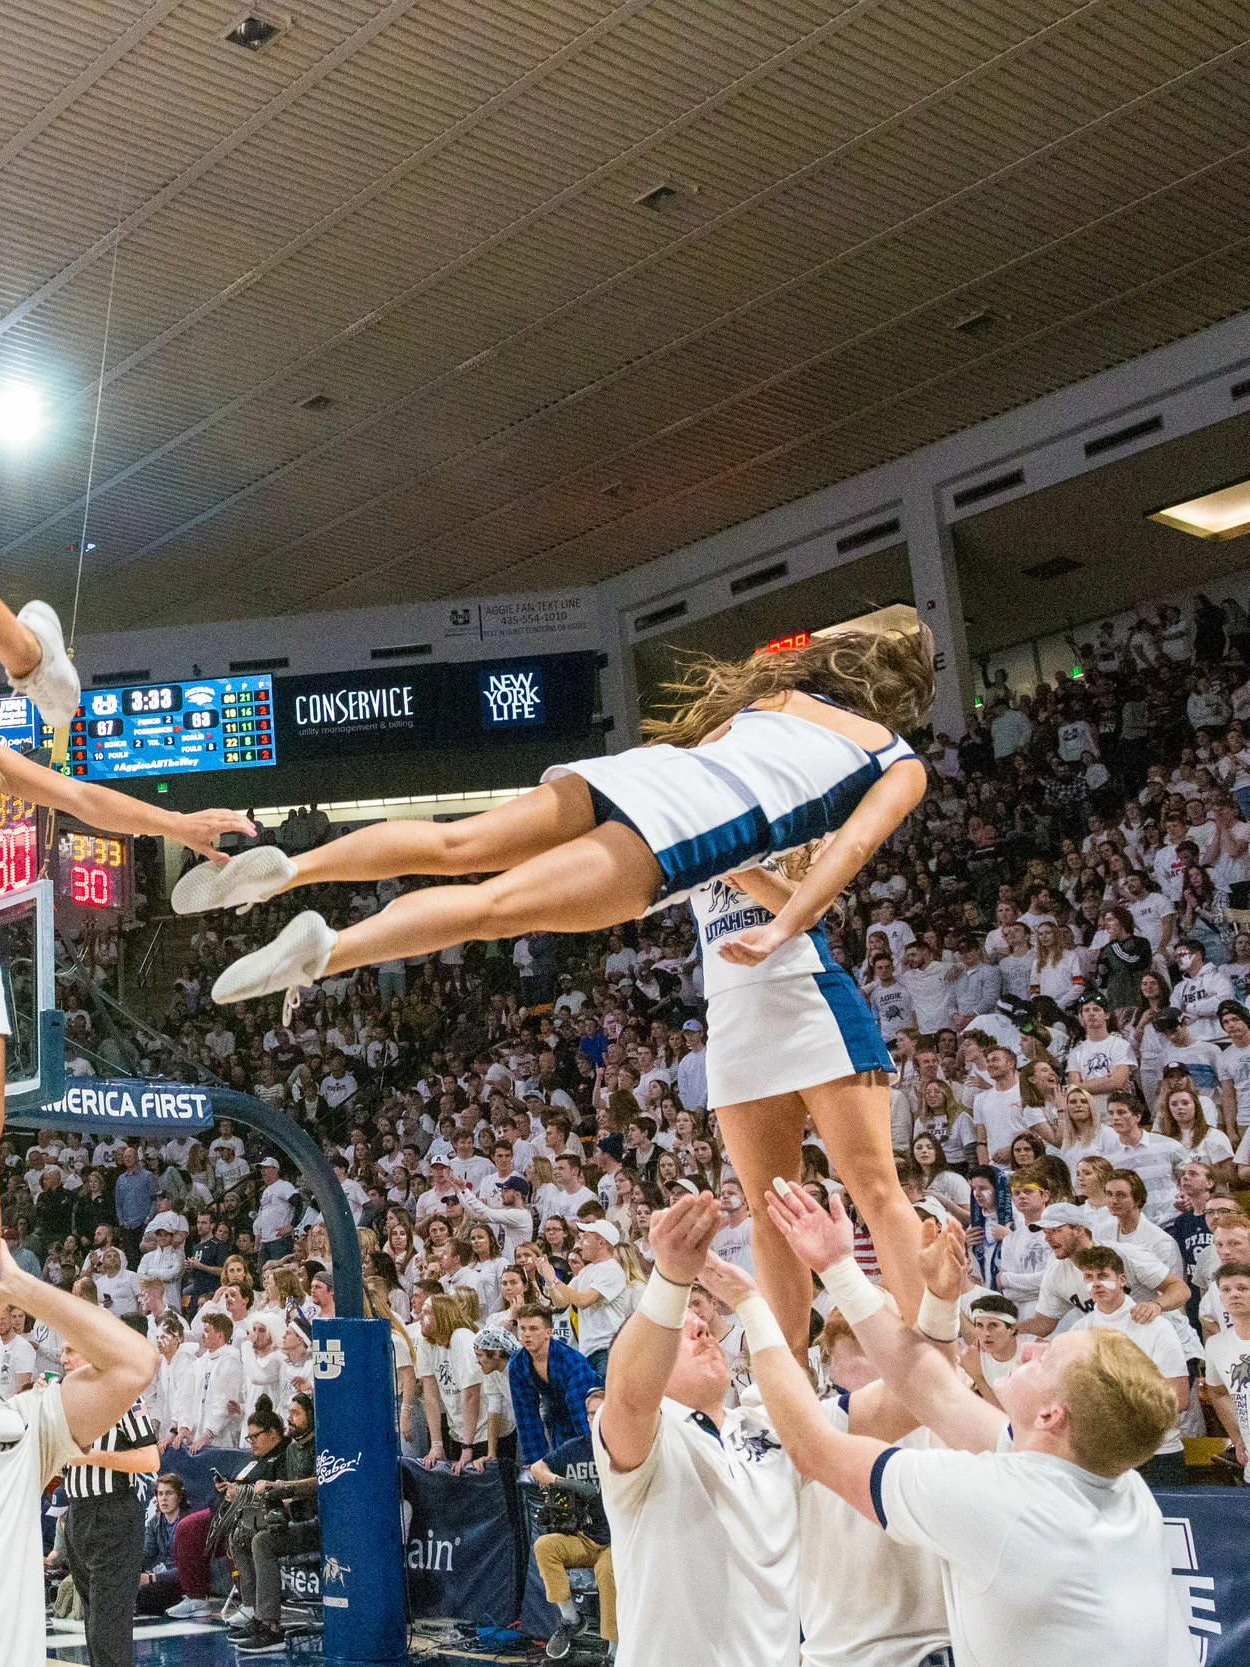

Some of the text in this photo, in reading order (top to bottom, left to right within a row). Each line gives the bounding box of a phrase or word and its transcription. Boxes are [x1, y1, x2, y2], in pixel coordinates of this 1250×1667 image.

[485, 598, 581, 615] AGGIE FAN TEXT LINE
[501, 612, 568, 625] 435-554-1010
[489, 672, 534, 692] NEW
[131, 688, 172, 711] 3:33
[240, 693, 251, 702] 21
[258, 691, 266, 700] 4
[483, 686, 541, 707] YORK
[241, 707, 252, 716] 16
[259, 706, 267, 715] 2
[295, 687, 414, 725] CONSERVICE
[492, 703, 536, 721] LIFE
[42, 726, 53, 734] 12
[225, 724, 237, 732] 11
[241, 722, 252, 731] 11
[261, 720, 268, 729] 4
[321, 722, 378, 734] management
[389, 718, 414, 730] billing
[42, 740, 53, 748] 15
[225, 738, 238, 747] 22
[244, 736, 251, 746] 8
[261, 735, 269, 744] 3
[94, 752, 104, 760] 10
[226, 753, 239, 762] 24
[245, 751, 252, 760] 6
[262, 750, 269, 759] 2
[77, 765, 84, 775] 2
[73, 834, 122, 867] 3:33
[74, 867, 108, 904] 30
[705, 910, 743, 945] UTAH
[879, 992, 902, 1003] AGGIE
[141, 1093, 207, 1119] FIRST
